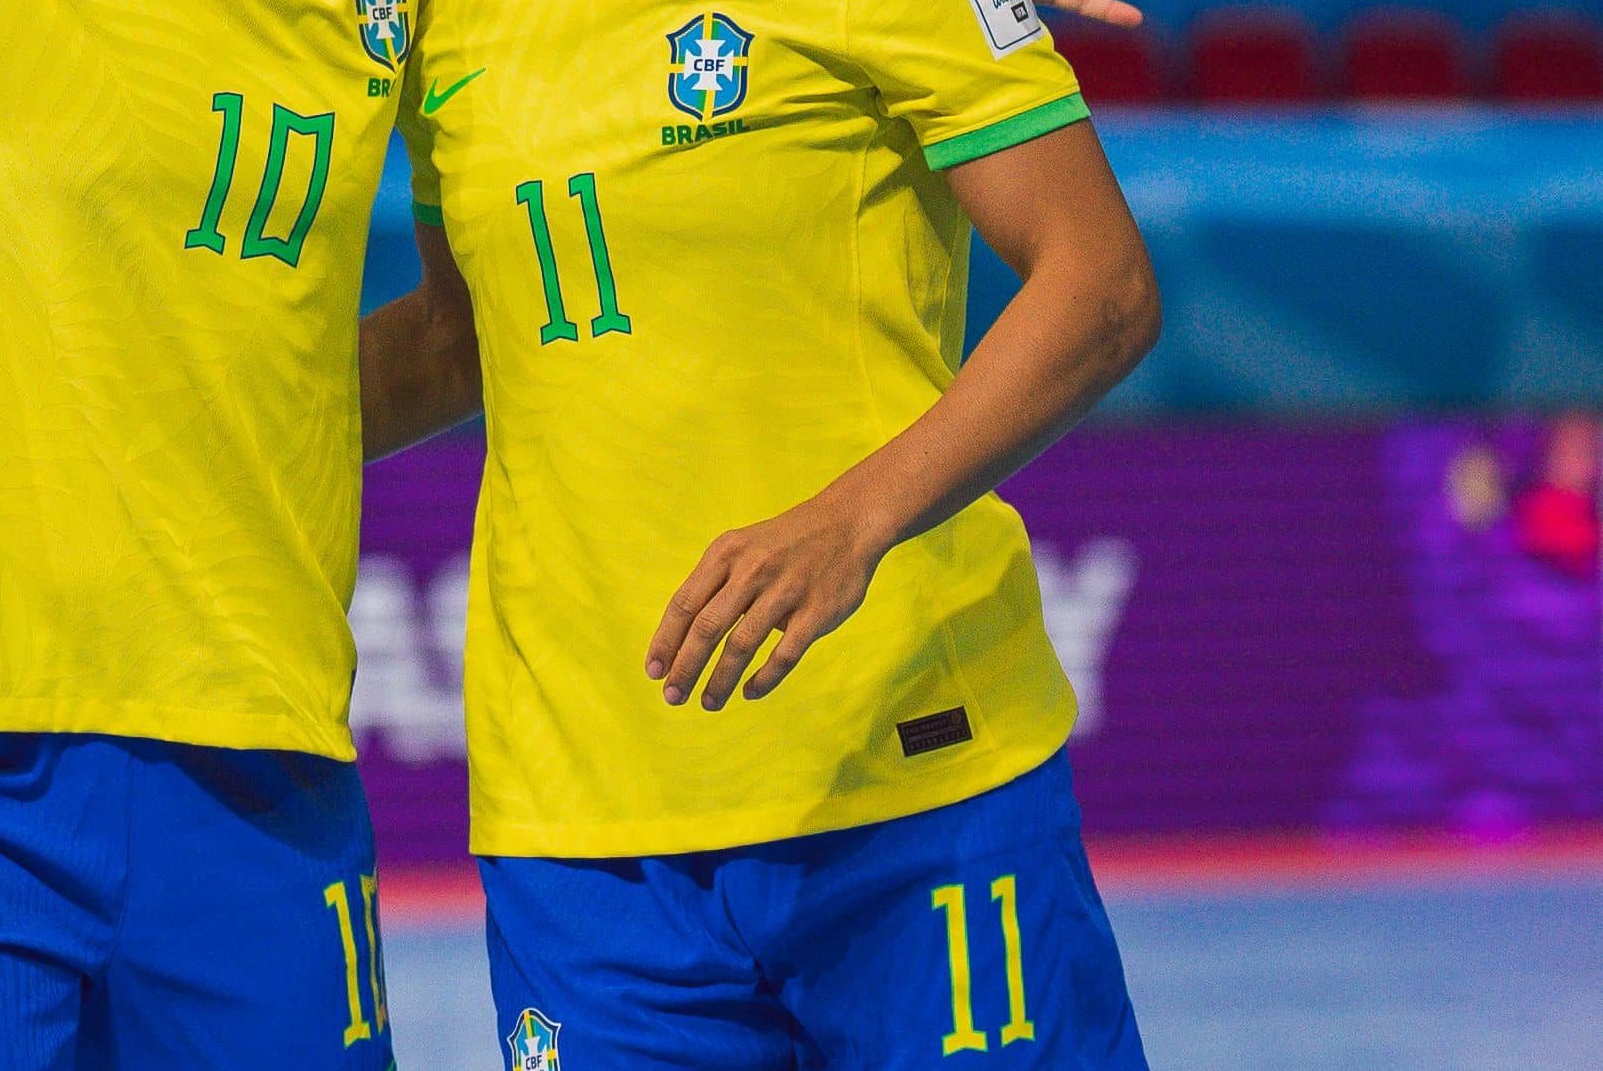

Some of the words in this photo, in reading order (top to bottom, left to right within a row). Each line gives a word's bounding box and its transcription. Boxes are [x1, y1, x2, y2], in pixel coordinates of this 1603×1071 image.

[372, 7, 392, 21] CBF
[693, 58, 725, 72] CBF
[367, 77, 397, 98] BR
[661, 118, 751, 146] BRASIL
[184, 91, 336, 269] 10
[515, 172, 633, 346] 11
[930, 873, 1037, 1058] 11
[525, 1054, 543, 1071] CBF
